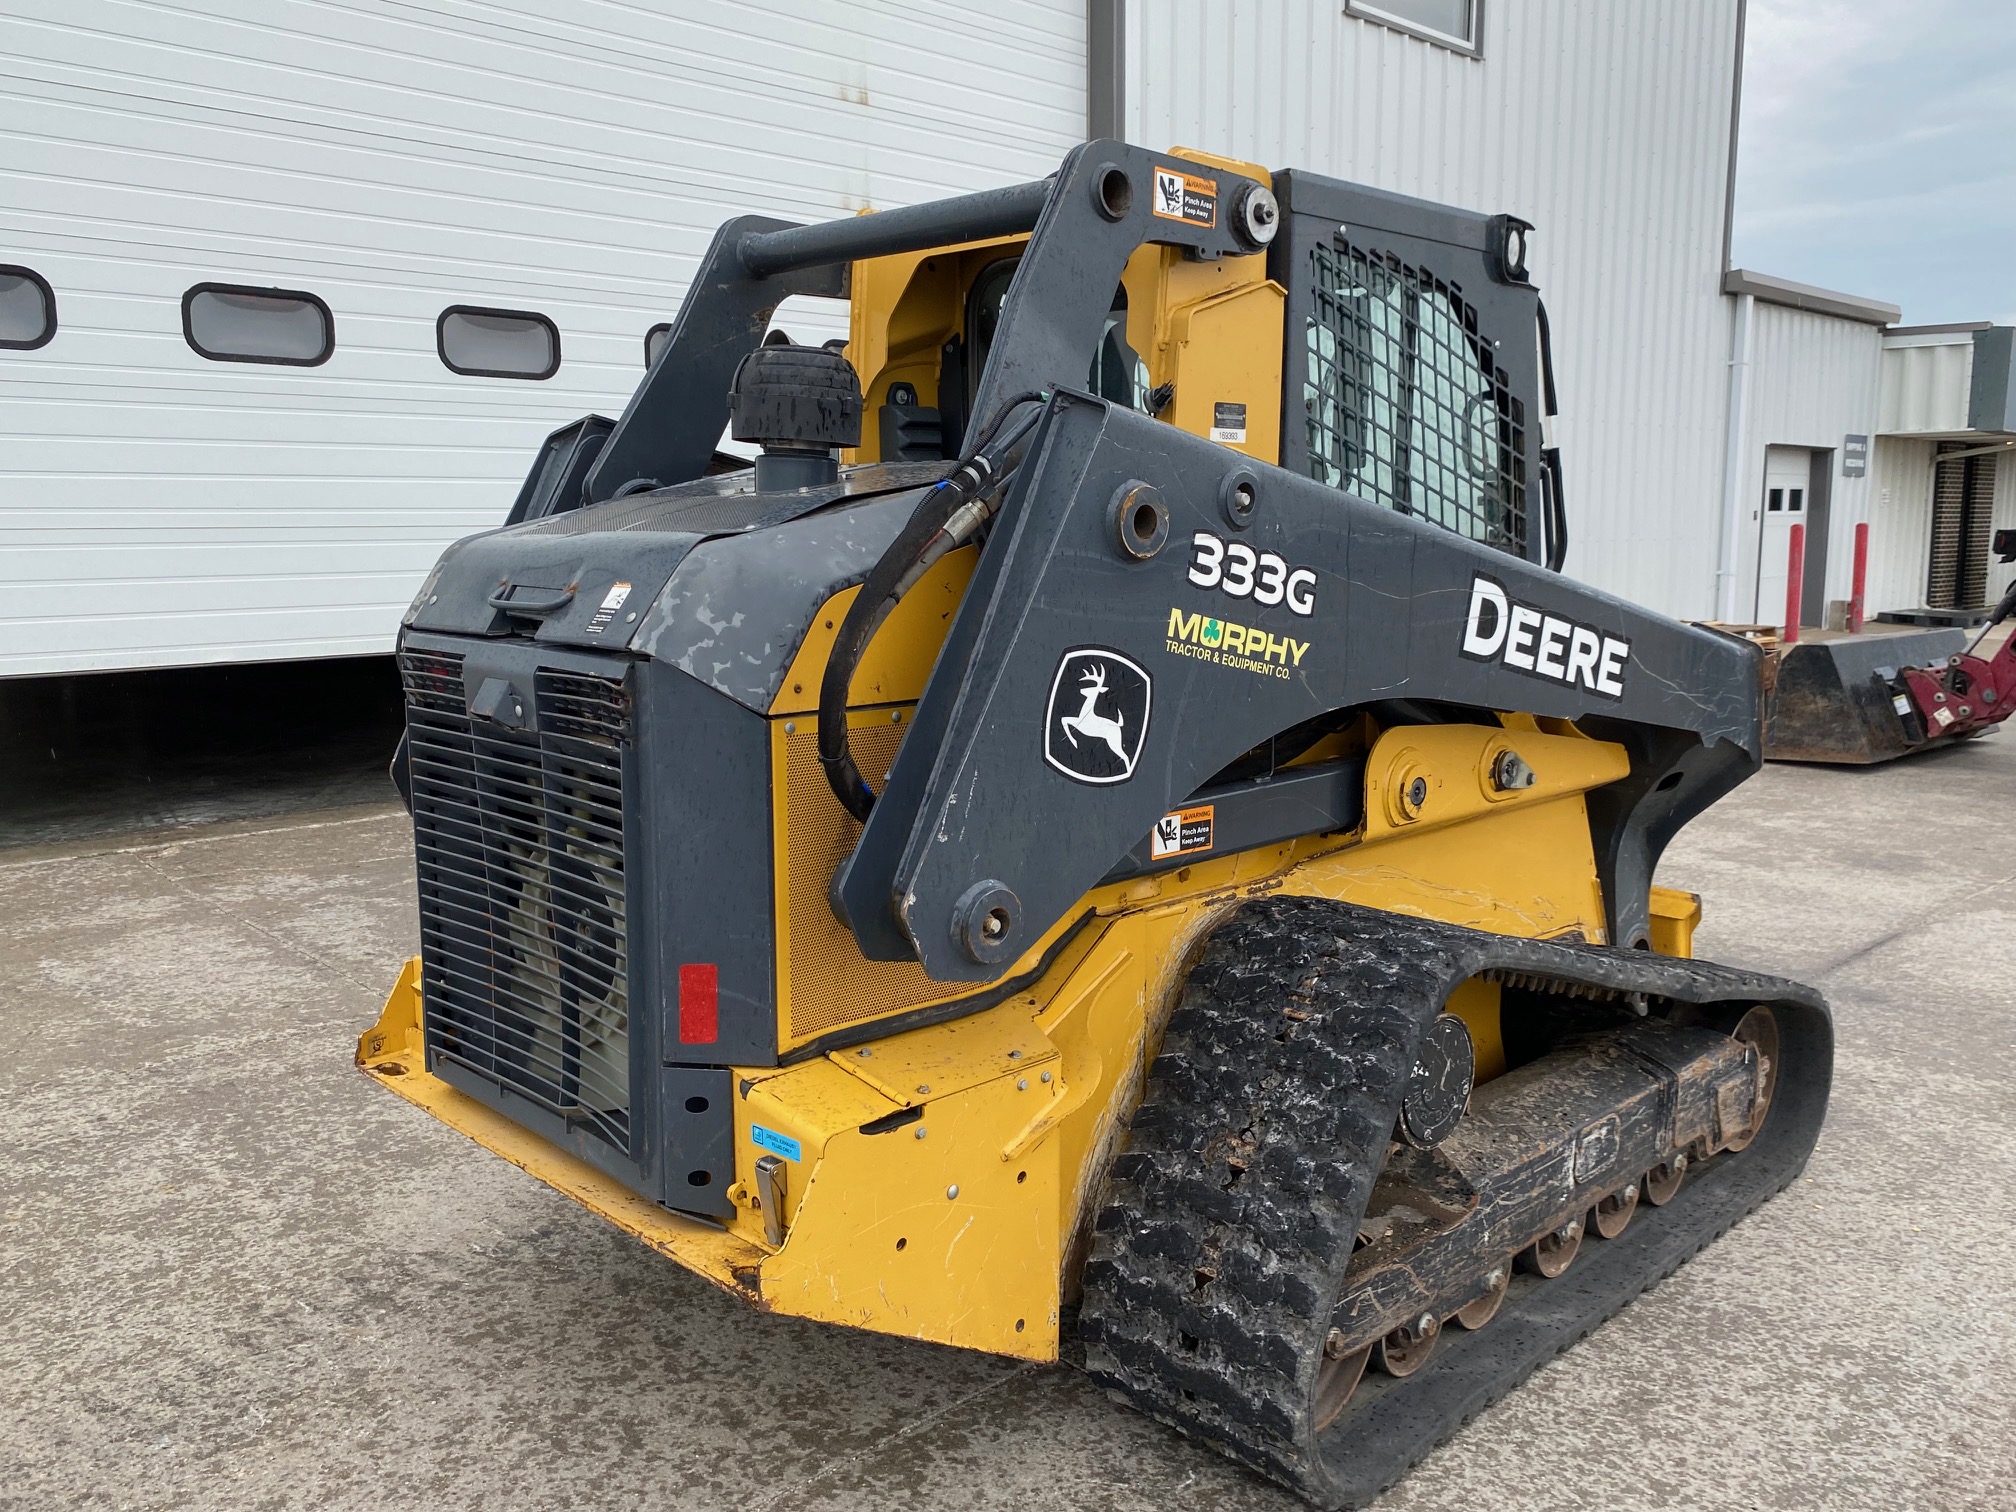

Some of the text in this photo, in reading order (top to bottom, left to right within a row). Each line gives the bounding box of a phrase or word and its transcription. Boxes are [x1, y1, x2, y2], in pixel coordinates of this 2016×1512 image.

[1184, 195, 1213, 210] Pinch Area
[1184, 206, 1209, 219] Keep Away
[1187, 532, 1318, 616] 333G
[1167, 607, 1311, 667] MURPHY
[1462, 577, 1630, 698] DEERE
[1165, 639, 1291, 680] TRACTOR & EQUIPMENT CO.
[1188, 810, 1211, 820] WARNING
[1181, 826, 1209, 836] Pinch Area
